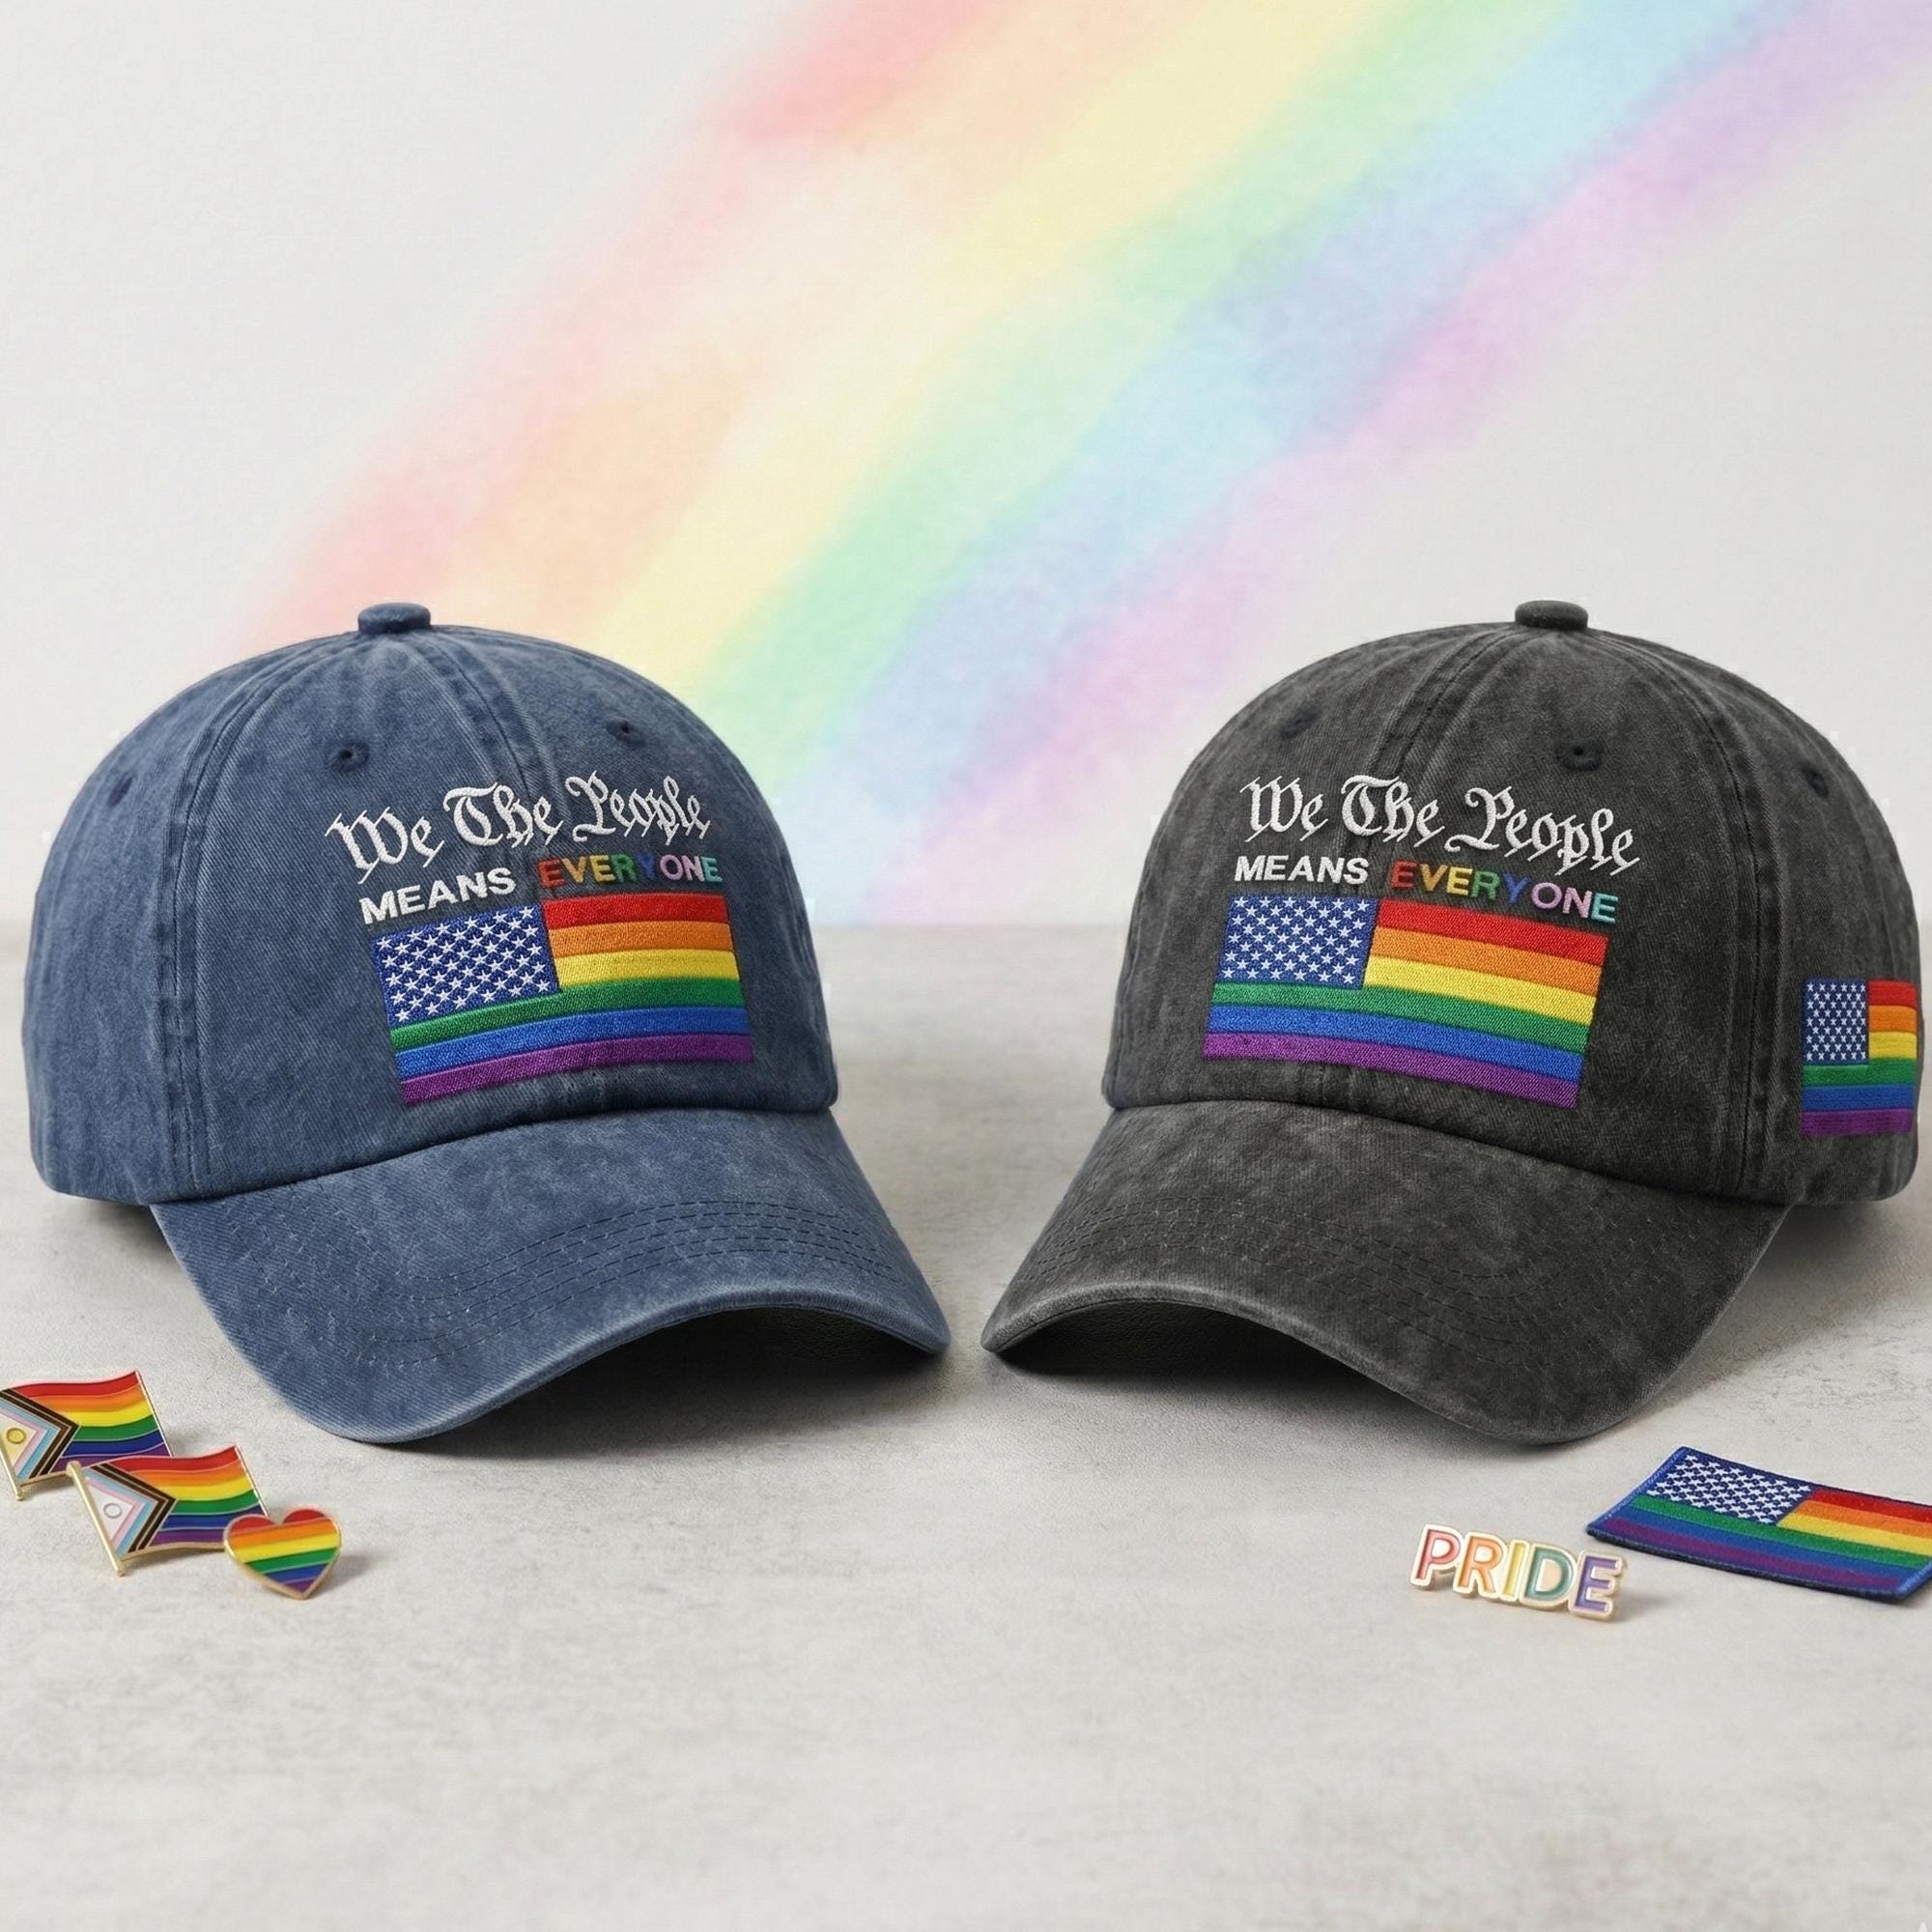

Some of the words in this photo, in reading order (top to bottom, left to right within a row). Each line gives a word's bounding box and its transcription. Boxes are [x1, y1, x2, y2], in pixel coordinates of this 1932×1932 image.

[325, 807, 445, 884] We
[442, 781, 563, 848] The
[564, 770, 712, 846] People
[1239, 776, 1329, 842] We
[1341, 775, 1445, 847] The
[1444, 785, 1640, 876] People
[358, 867, 517, 924] MEANS
[535, 854, 723, 889] EVERYONE
[1234, 855, 1370, 885] MEANS
[1390, 861, 1619, 924] EVERYONE
[1413, 1526, 1624, 1616] PRIDE
